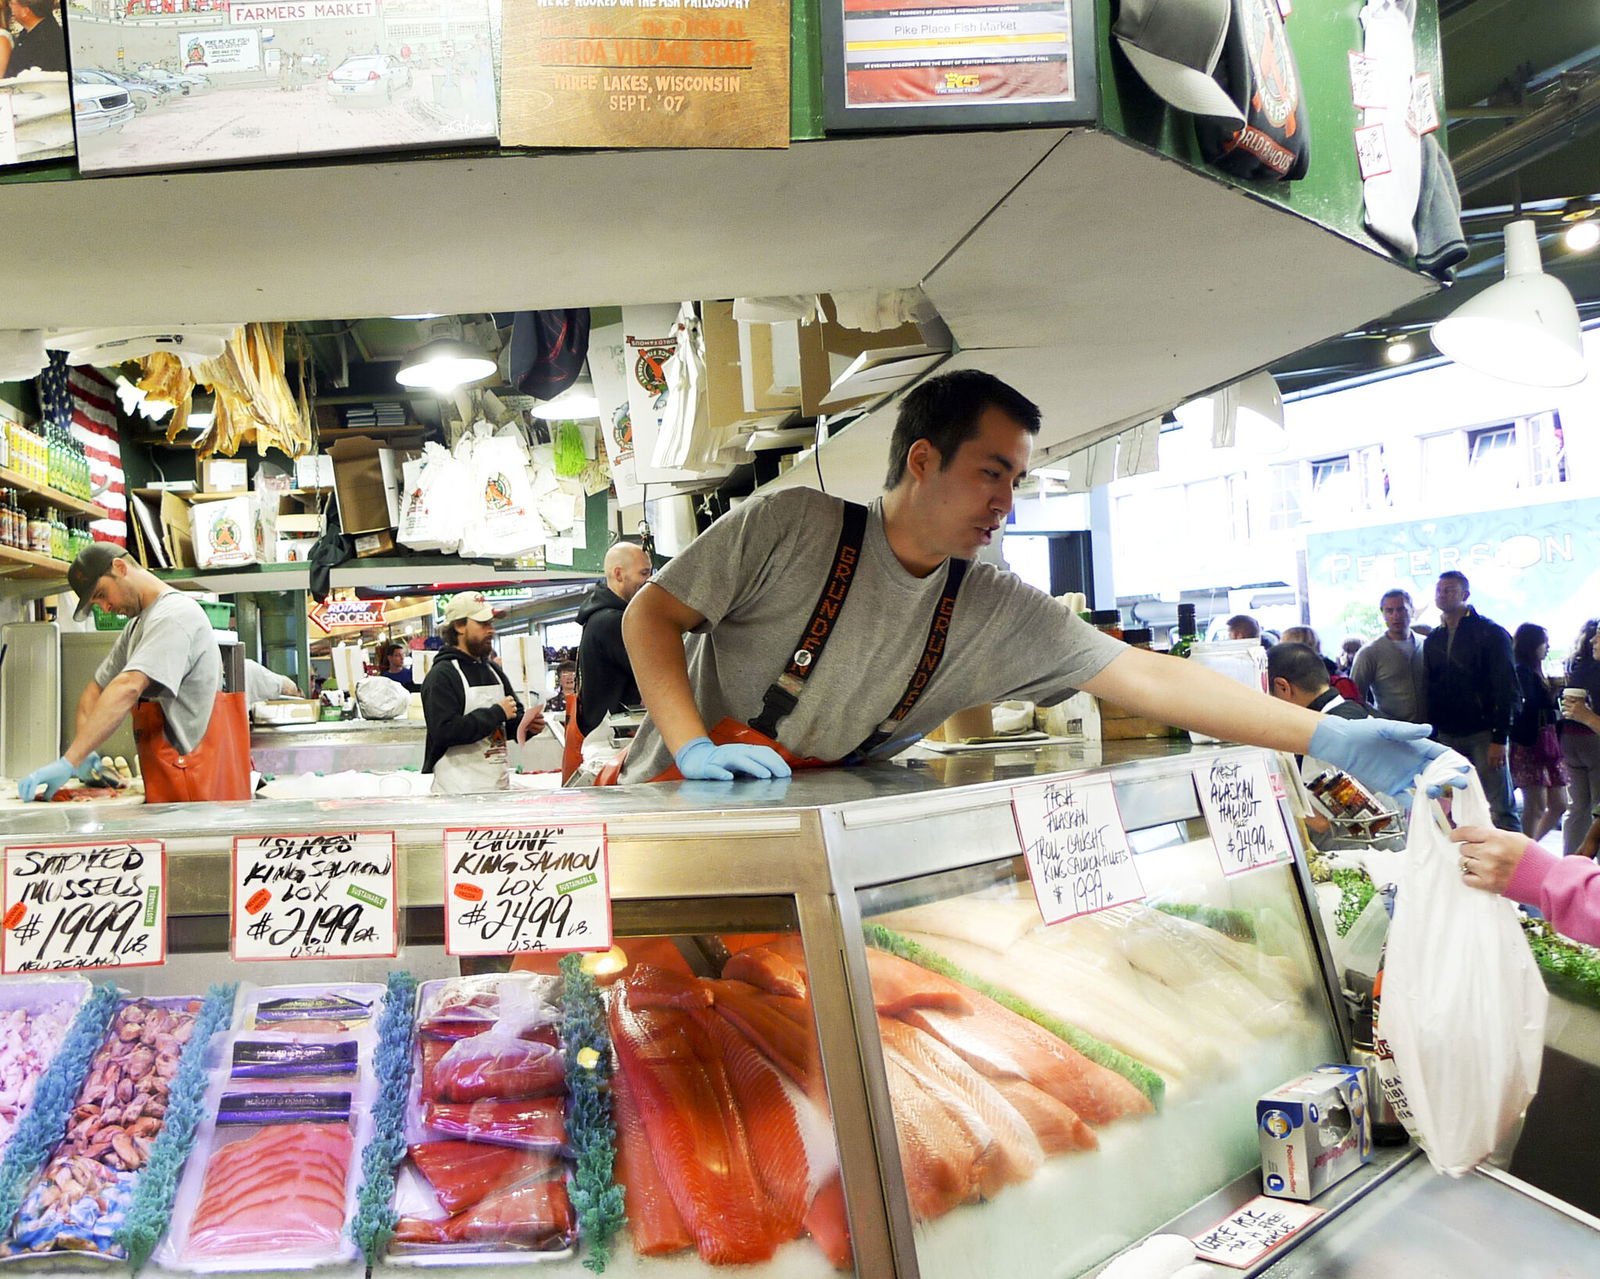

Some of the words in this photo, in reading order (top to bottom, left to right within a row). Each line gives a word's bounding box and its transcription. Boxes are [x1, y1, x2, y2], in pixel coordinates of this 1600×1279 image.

[236, 6, 305, 21] FARMERS
[314, 2, 373, 17] MARKET
[894, 26, 918, 35] Pike
[921, 24, 951, 34] Place
[954, 22, 976, 32] Fish
[980, 21, 1016, 32] Market
[702, 40, 756, 65] STAFF
[553, 75, 598, 90] THREE
[603, 75, 652, 94] LAKES,
[655, 75, 741, 92] WISCONSIN
[609, 95, 651, 112] SEPT.
[656, 95, 685, 112] '07
[1262, 142, 1294, 171] FAMOUS
[320, 611, 379, 624] GROCERY
[1210, 776, 1254, 806] ALASKAN
[1218, 799, 1262, 823] HALIBUT
[13, 843, 144, 877] SMOKED
[243, 860, 307, 886] KING
[308, 853, 392, 879] SALMON
[452, 852, 518, 876] KING
[520, 846, 600, 872] SALMON
[20, 874, 144, 905] MUSSELS
[281, 881, 330, 903] LOX
[350, 886, 386, 906] SUSTAINABLE
[496, 873, 548, 897] LOX
[17, 958, 49, 973] NEW
